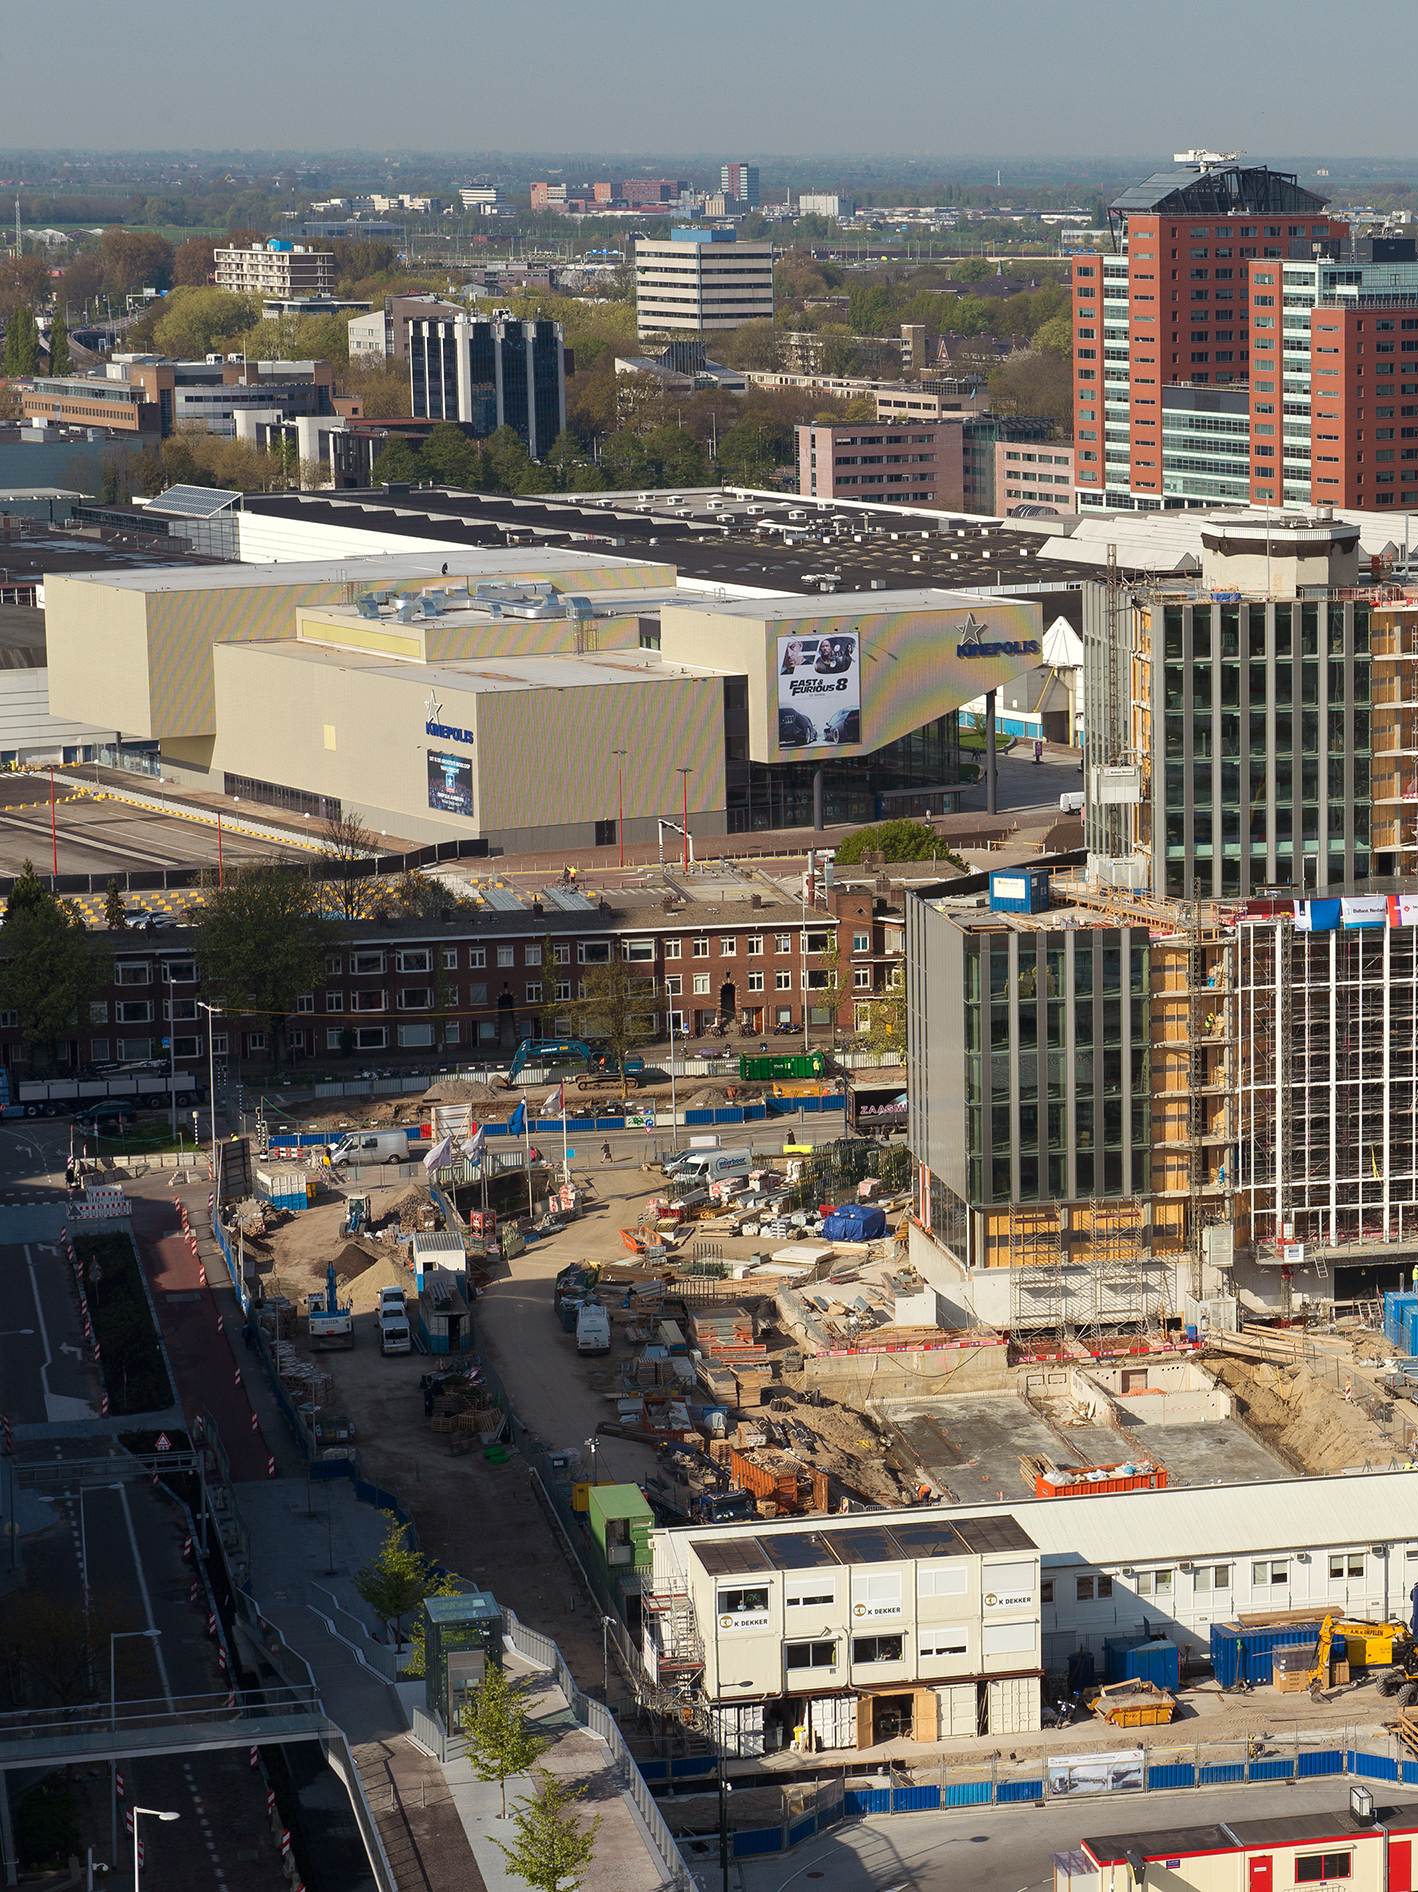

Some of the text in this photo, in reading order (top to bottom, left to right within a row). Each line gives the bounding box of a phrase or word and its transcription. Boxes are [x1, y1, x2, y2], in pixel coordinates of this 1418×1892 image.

[956, 640, 1038, 657] KINEPOLIS
[789, 679, 818, 690] FAST
[792, 678, 848, 696] FURIOUS 8
[425, 722, 474, 745] KINEPOLIS
[1005, 1596, 1032, 1604] DEKKER
[874, 1606, 901, 1614] DEKKER
[741, 1618, 768, 1626] DEKKER
